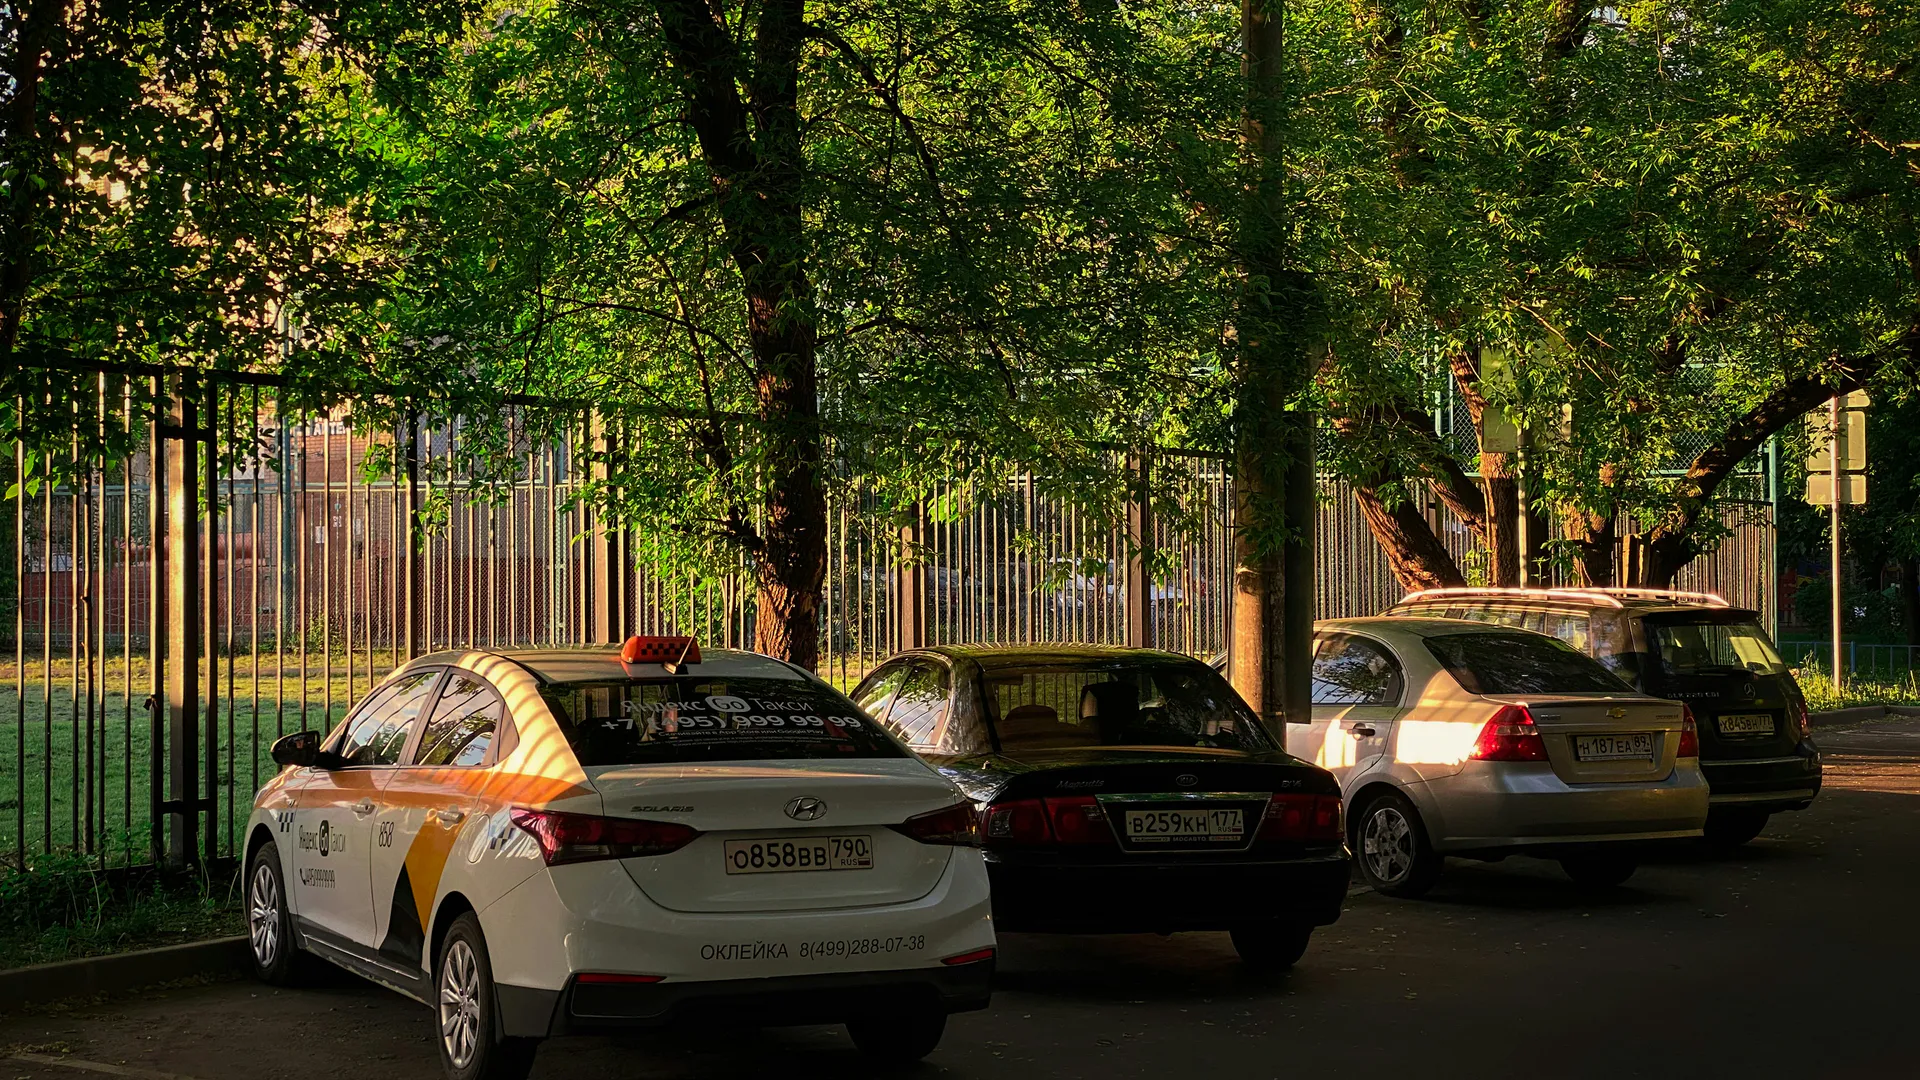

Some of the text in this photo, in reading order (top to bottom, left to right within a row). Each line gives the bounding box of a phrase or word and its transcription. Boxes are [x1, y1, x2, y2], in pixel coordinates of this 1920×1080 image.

[620, 698, 813, 713] Яндекс Go Такси
[601, 718, 634, 730] +7
[732, 715, 785, 727] 999
[789, 715, 824, 727] 99
[827, 716, 861, 728] 99
[1634, 736, 1646, 748] 89
[630, 805, 695, 813] SOLARIS
[1132, 811, 1239, 833] В259КН 177
[379, 821, 395, 848] 858
[734, 838, 866, 869] О858ВВ 790
[841, 858, 858, 866] RUS
[700, 934, 925, 961] ОКЛЕЙКА 8(499)288-07-38
